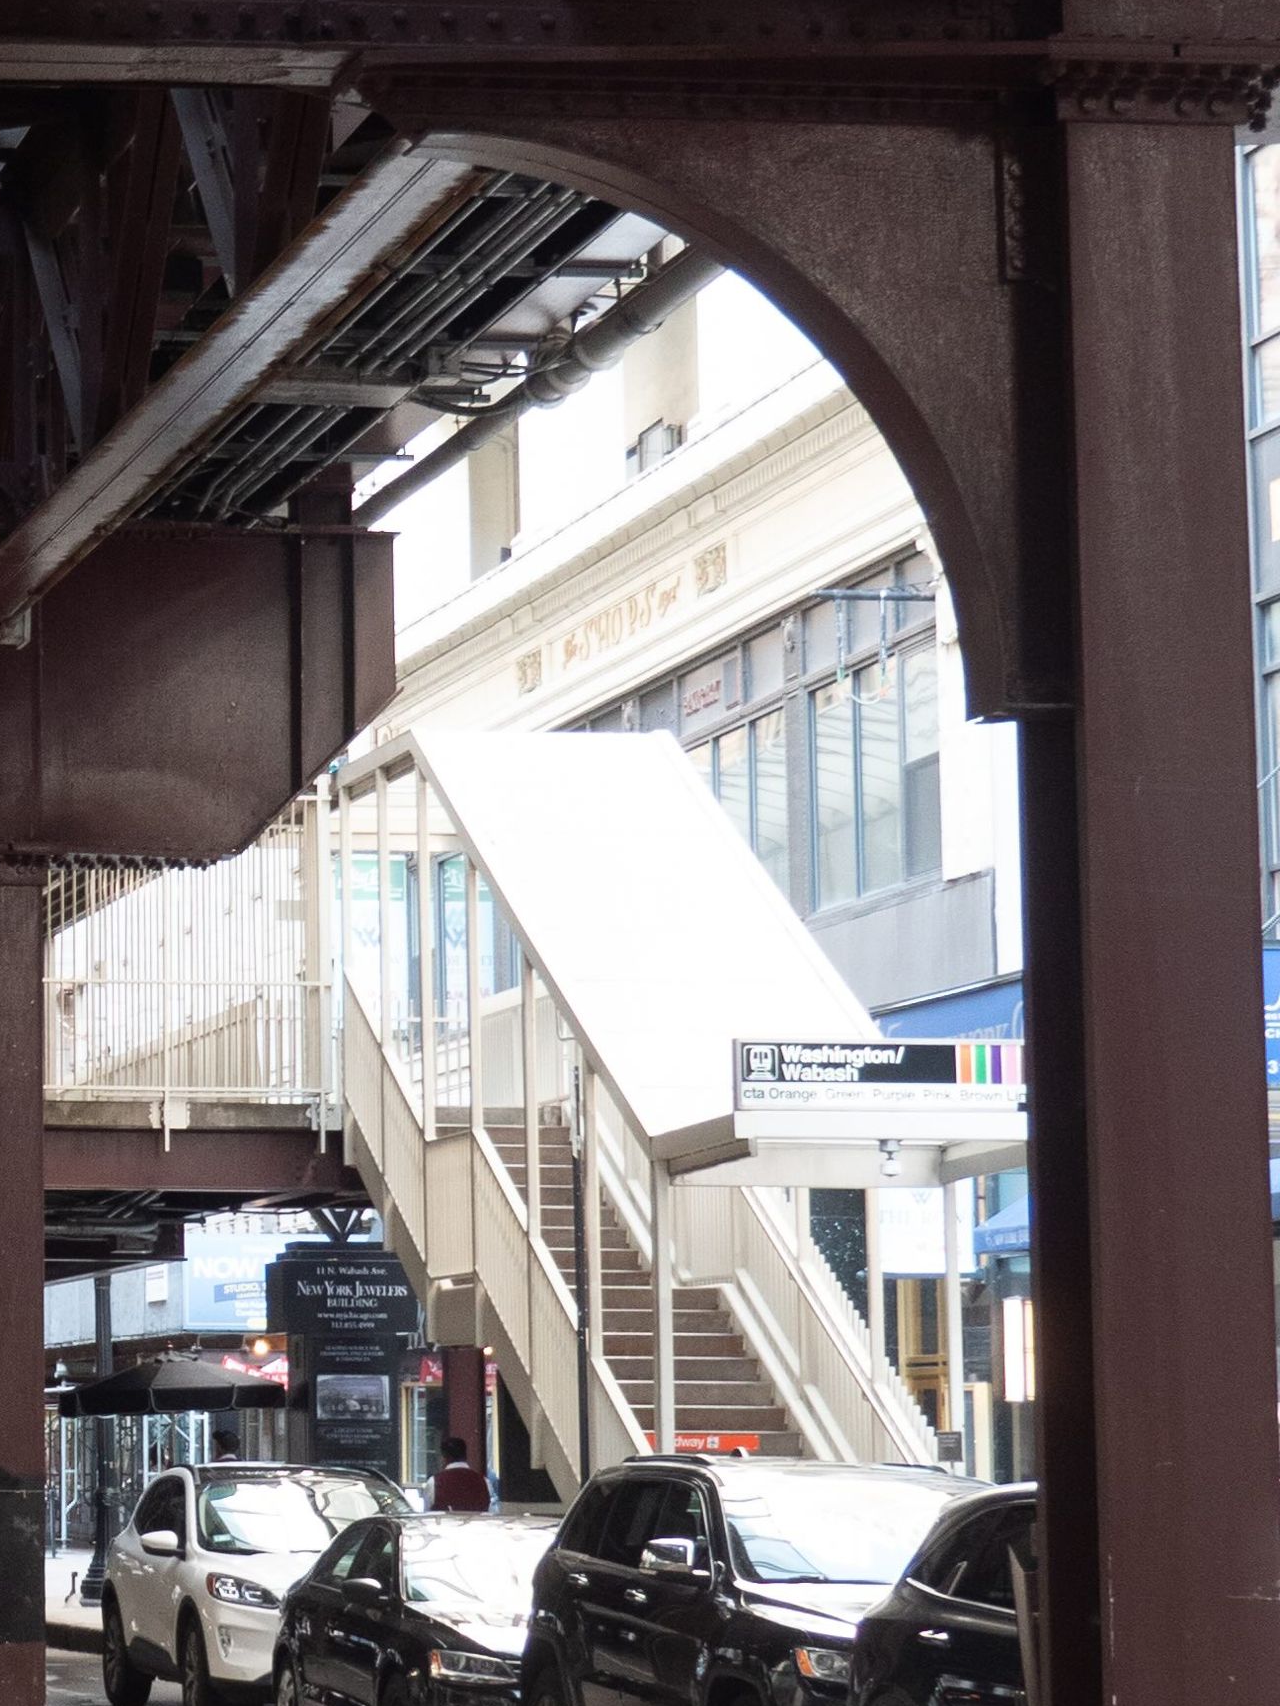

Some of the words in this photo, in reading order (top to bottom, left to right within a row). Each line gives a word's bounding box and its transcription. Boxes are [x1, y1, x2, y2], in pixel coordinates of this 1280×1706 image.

[780, 1045, 905, 1068] Washington/
[781, 1063, 860, 1081] Wabash
[743, 1087, 765, 1099] cta
[193, 1257, 259, 1279] NOW
[339, 1266, 369, 1275] Wabash
[370, 1267, 389, 1275] Ave.
[327, 1298, 379, 1308] BUILDING
[674, 1436, 705, 1449] dway
